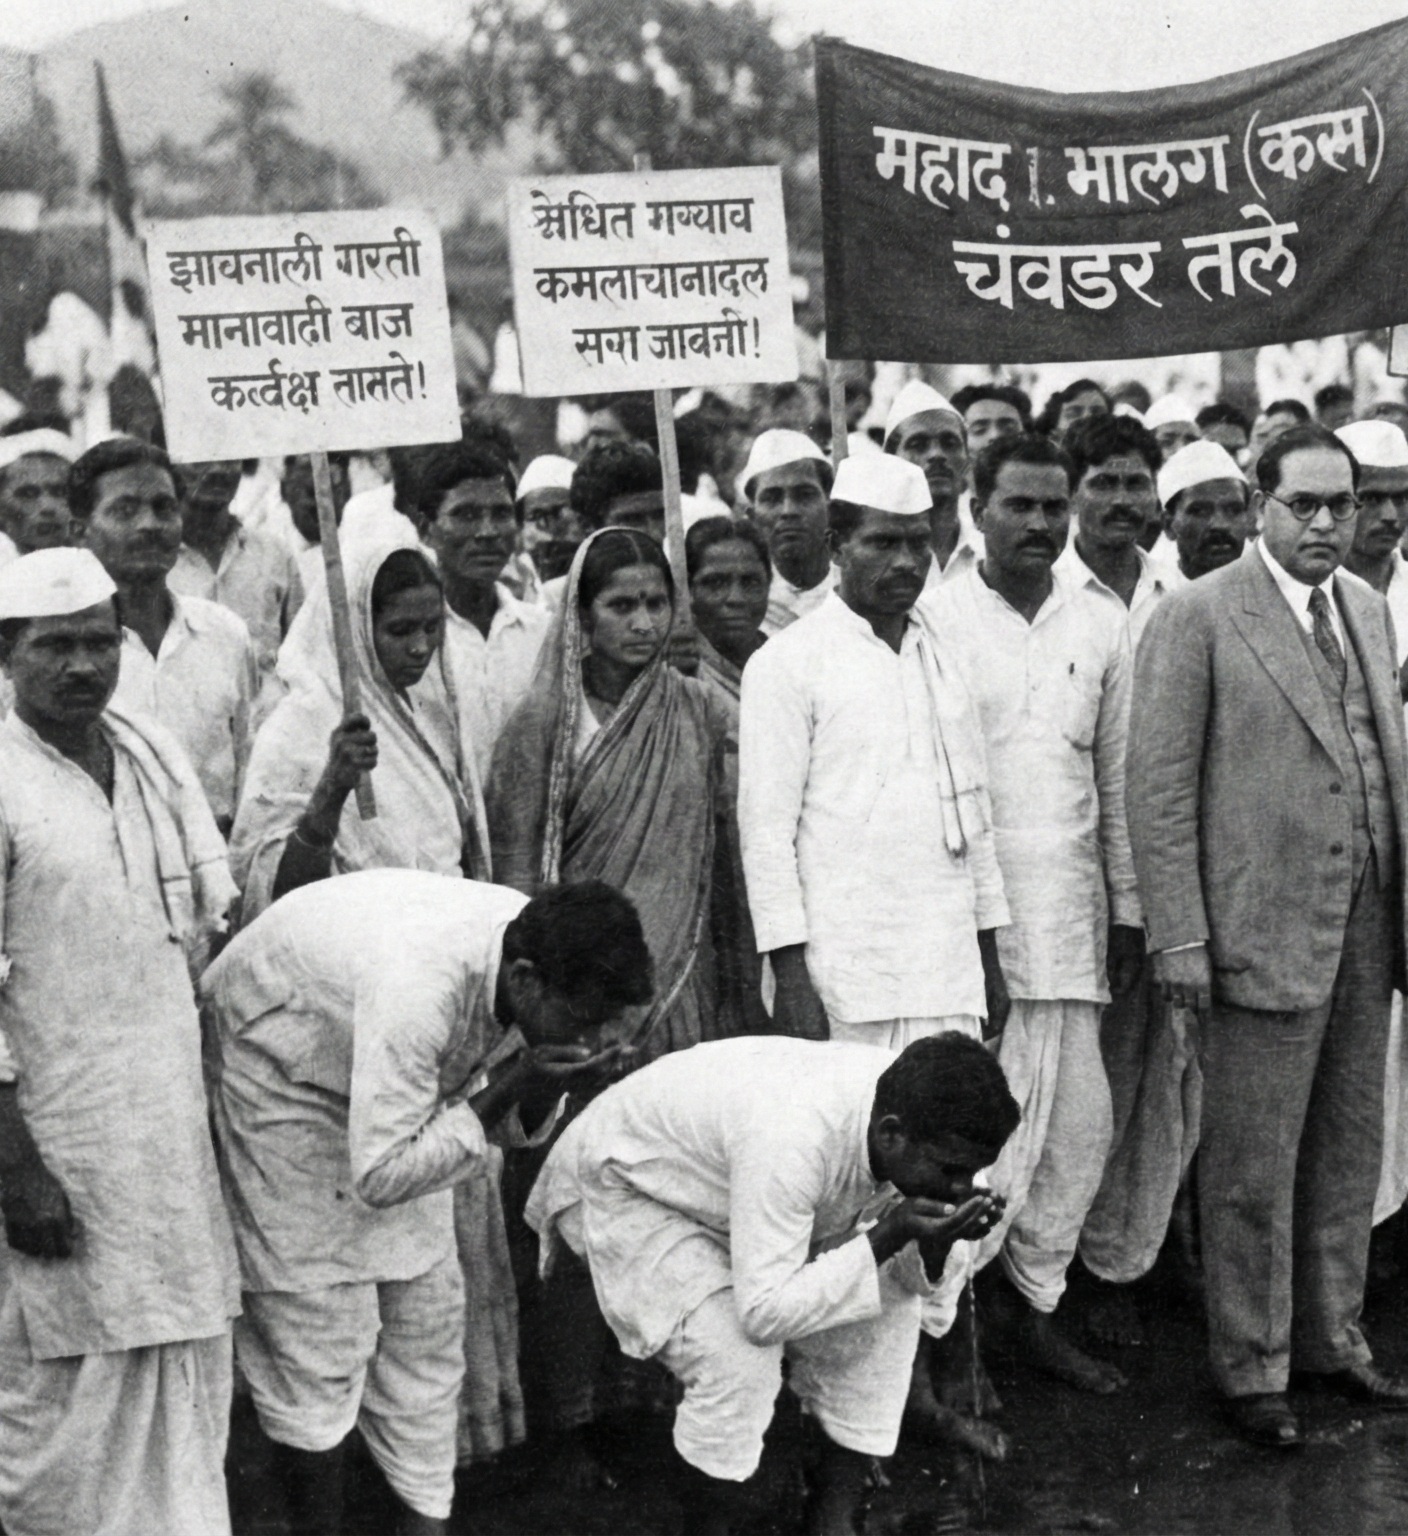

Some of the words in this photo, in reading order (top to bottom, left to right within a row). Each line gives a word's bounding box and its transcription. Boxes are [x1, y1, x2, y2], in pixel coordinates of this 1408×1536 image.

[1065, 136, 1229, 204] भालग
[953, 225, 1162, 309] चंवडर
[1182, 204, 1298, 301] तले
[341, 303, 414, 340] बाज
